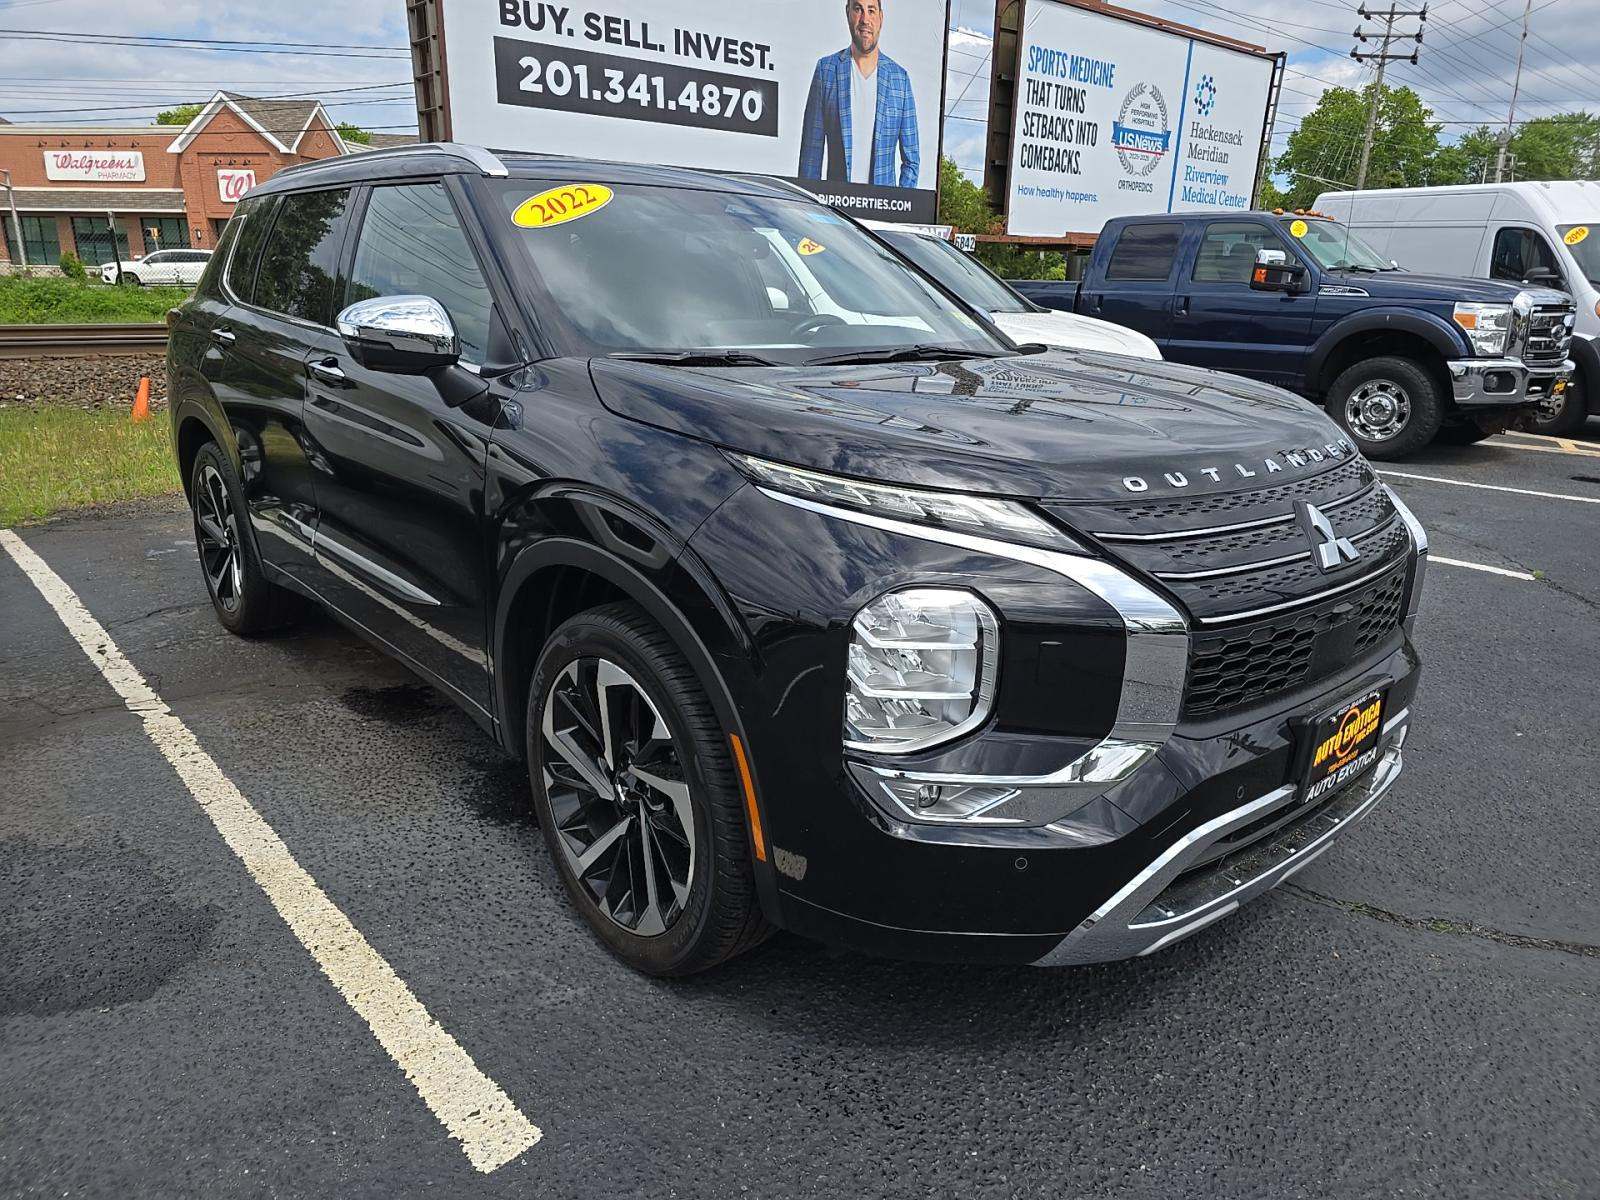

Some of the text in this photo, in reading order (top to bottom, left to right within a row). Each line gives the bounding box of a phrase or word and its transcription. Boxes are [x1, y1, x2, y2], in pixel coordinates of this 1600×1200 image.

[499, 0, 775, 71] BUY. SELL. INVEST.
[1028, 45, 1115, 88] SPORTS MEDICINE
[518, 56, 763, 122] 201.341.4870
[1026, 78, 1086, 114] THAT TURNS
[1023, 110, 1098, 147] SETBACKS INTO
[1190, 121, 1243, 146] Hackensack
[53, 153, 136, 174] Walgreens
[1020, 143, 1081, 175] COMEBACKS.
[1187, 142, 1229, 164] Meridian
[97, 171, 137, 180] PHARMACY
[1118, 179, 1153, 193] ORTHOPEDICS
[1184, 164, 1229, 186] Riverview
[530, 187, 597, 223] 2022
[1017, 184, 1036, 196] How
[1036, 186, 1065, 202] healthy
[1181, 185, 1247, 208] Medical Center
[1122, 438, 1351, 493] OUTLANDER
[1312, 729, 1343, 767] AUTO
[1343, 700, 1380, 746] EXOTICA
[1304, 773, 1337, 803] AUTO
[1337, 746, 1377, 783] EXOTICA
